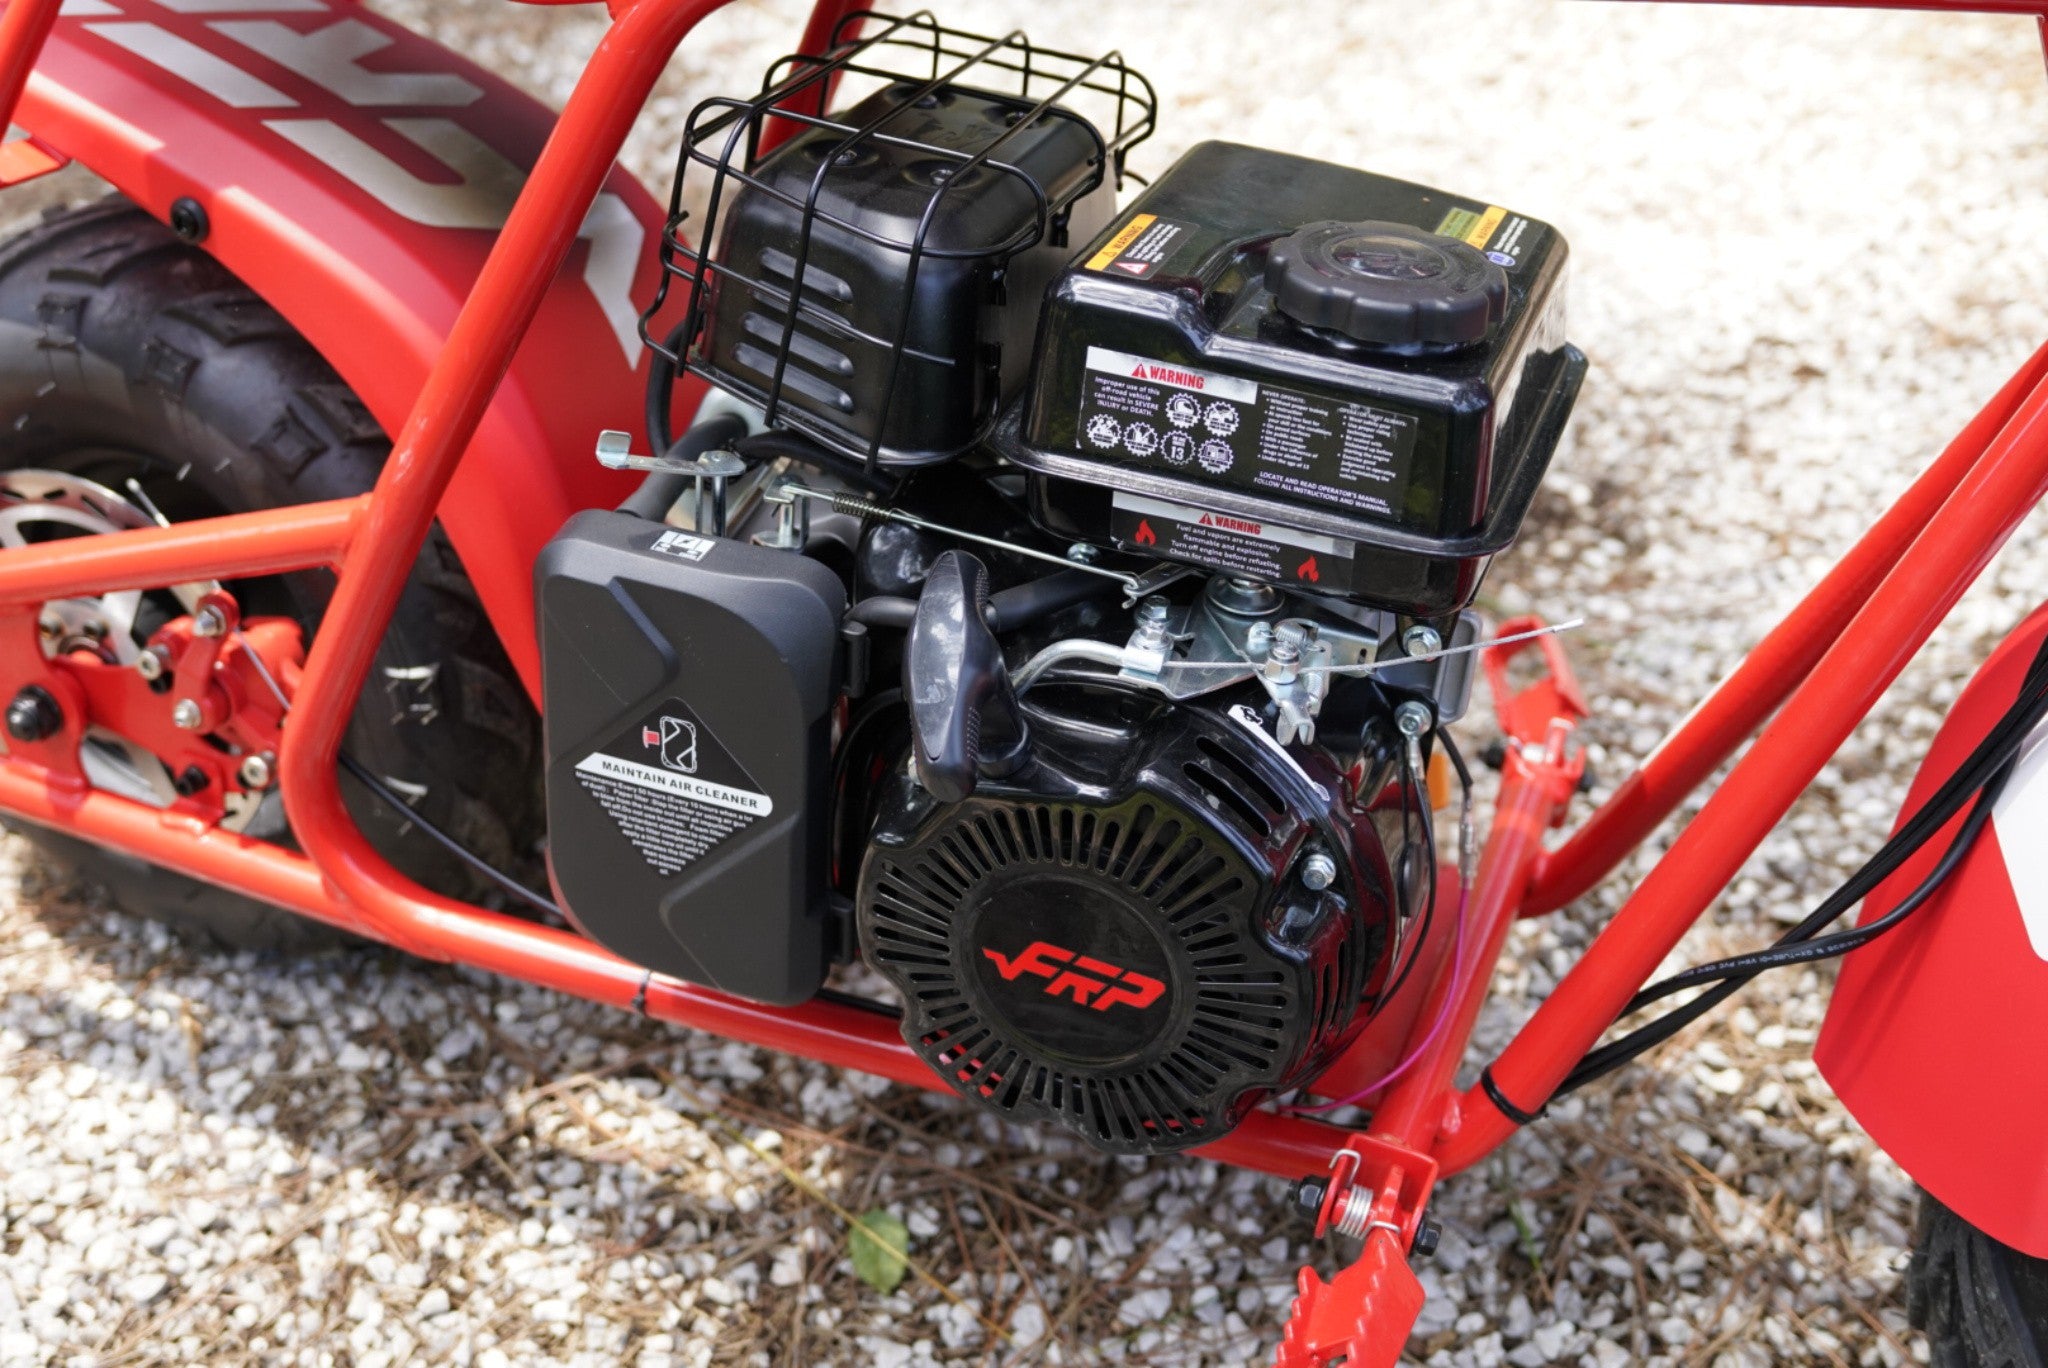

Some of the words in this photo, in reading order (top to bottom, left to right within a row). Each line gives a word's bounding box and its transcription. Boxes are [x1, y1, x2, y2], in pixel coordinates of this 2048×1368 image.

[1113, 225, 1143, 249] WARNING
[1095, 376, 1125, 388] Improper
[1147, 387, 1160, 396] this
[1150, 366, 1204, 389] WARNING
[1101, 385, 1128, 396] off-road
[1128, 392, 1151, 401] vehicle
[1106, 394, 1126, 403] result
[1126, 397, 1134, 405] in
[1135, 400, 1158, 410] SEVERE
[1097, 399, 1120, 409] INJURY
[1130, 406, 1152, 416] DEATH.
[1171, 446, 1184, 460] 13
[1259, 471, 1283, 482] LOCATE
[1284, 477, 1299, 485] AND
[1299, 480, 1317, 489] READ
[1317, 485, 1357, 499] OPERATOR'S
[1357, 494, 1387, 506] MANUAL.
[1215, 516, 1261, 534] WARNING
[1176, 523, 1192, 532] Fuel
[1192, 528, 1206, 536] and
[1207, 531, 1231, 541] vapors
[1244, 540, 1280, 552] extremely
[1183, 533, 1220, 547] flammable
[1221, 543, 1235, 551] and
[1236, 547, 1270, 558] explosive.
[1169, 548, 1190, 558] Check
[1191, 552, 1202, 560] for
[1203, 556, 1221, 564] spills
[1221, 559, 1245, 570] before
[1246, 565, 1281, 578] restarting.
[1171, 539, 1187, 549] Turn
[1199, 547, 1223, 557] engine
[1224, 551, 1247, 562] before
[1248, 558, 1281, 570] refueling.
[602, 761, 666, 785] MAINTAIN
[669, 779, 691, 792] AIR
[695, 786, 757, 808] CLEANER
[982, 941, 1166, 1011] FRP
